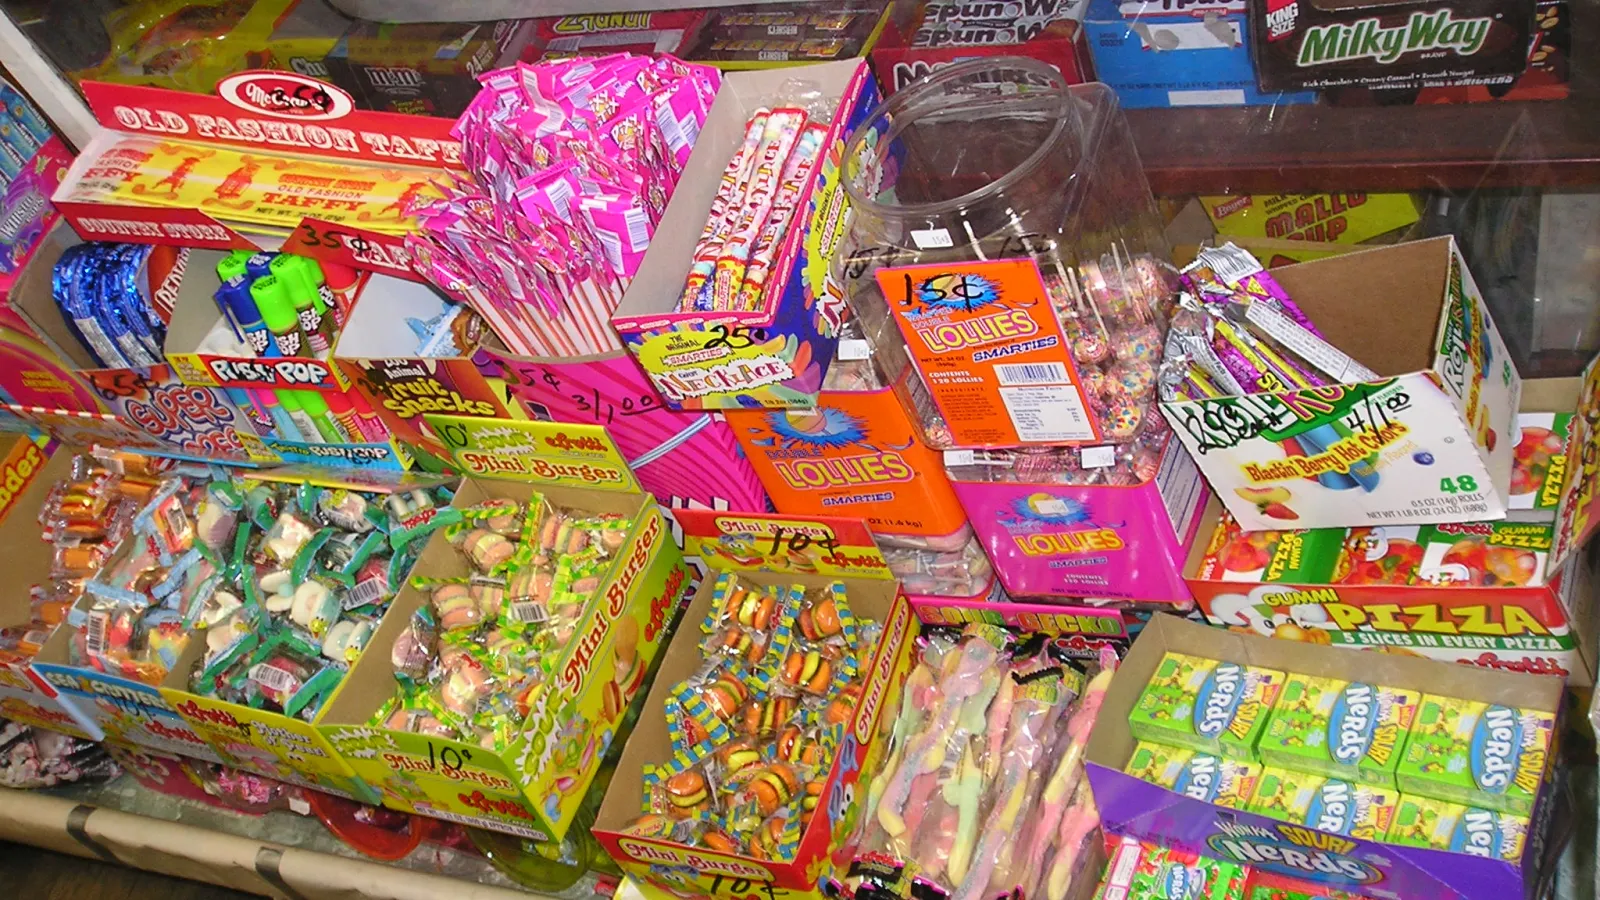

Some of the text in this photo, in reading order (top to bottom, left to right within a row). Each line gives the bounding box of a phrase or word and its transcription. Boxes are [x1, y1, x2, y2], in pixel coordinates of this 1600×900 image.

[1266, 3, 1299, 28] KING
[1271, 19, 1296, 37] SIZE
[465, 60, 483, 80] 24
[114, 106, 463, 167] OLD FASHION TAFF
[262, 192, 369, 211] TAFFY
[278, 184, 365, 199] OLD FASHION
[78, 217, 232, 243] COUNTRY STORE
[904, 273, 983, 314] 15¢
[919, 308, 1039, 352] LOLLIES
[668, 348, 724, 365] SMARTIES
[973, 337, 1058, 362] SMARTIES
[275, 362, 328, 384] POP
[384, 365, 426, 380] Animal
[658, 361, 785, 398] NECKLACE
[126, 384, 228, 437] SUPER
[764, 448, 825, 459] DOUBLE
[1248, 462, 1298, 482] Blastin'
[1299, 450, 1345, 478] Berry
[1335, 442, 1363, 464] Hot
[464, 452, 620, 483] Mini Burger
[774, 450, 914, 490] LOLLIES
[1541, 455, 1568, 507] PIZZA
[1440, 474, 1478, 494] 48
[822, 491, 894, 506] SMARTIES
[1411, 493, 1485, 508] 0.5 OZ (14g) ROLLS
[907, 519, 923, 529] kg)
[1366, 511, 1381, 520] NET
[1381, 510, 1396, 519] WT
[1402, 509, 1414, 517] LB
[1421, 508, 1432, 516] OZ
[1433, 506, 1446, 516] (24
[1446, 505, 1462, 515] OZ)
[720, 519, 830, 538] Mini Burger
[1437, 522, 1546, 536] efrutti GUMMI
[769, 527, 840, 559] 10¢
[1012, 528, 1126, 557] LOLLIES
[1288, 536, 1302, 570] GUMMI
[1049, 557, 1108, 569] SMARTIES
[1267, 533, 1296, 581] PIZZA
[564, 516, 660, 694] Mini Burger
[644, 563, 686, 643] efrutti
[1262, 588, 1341, 607] GUMMI
[919, 606, 1123, 635] SOUR GECKO
[1323, 602, 1552, 638] PIZZA
[1344, 633, 1563, 651] 5 SLICES IN EVERY PIZZA
[46, 671, 81, 694] SEA
[859, 604, 908, 741] Mini Burger
[428, 741, 472, 771] 10¢
[383, 752, 514, 790] Mini Burger
[1213, 819, 1359, 856] WONKA SOUR!
[625, 842, 768, 879] Mini Burger
